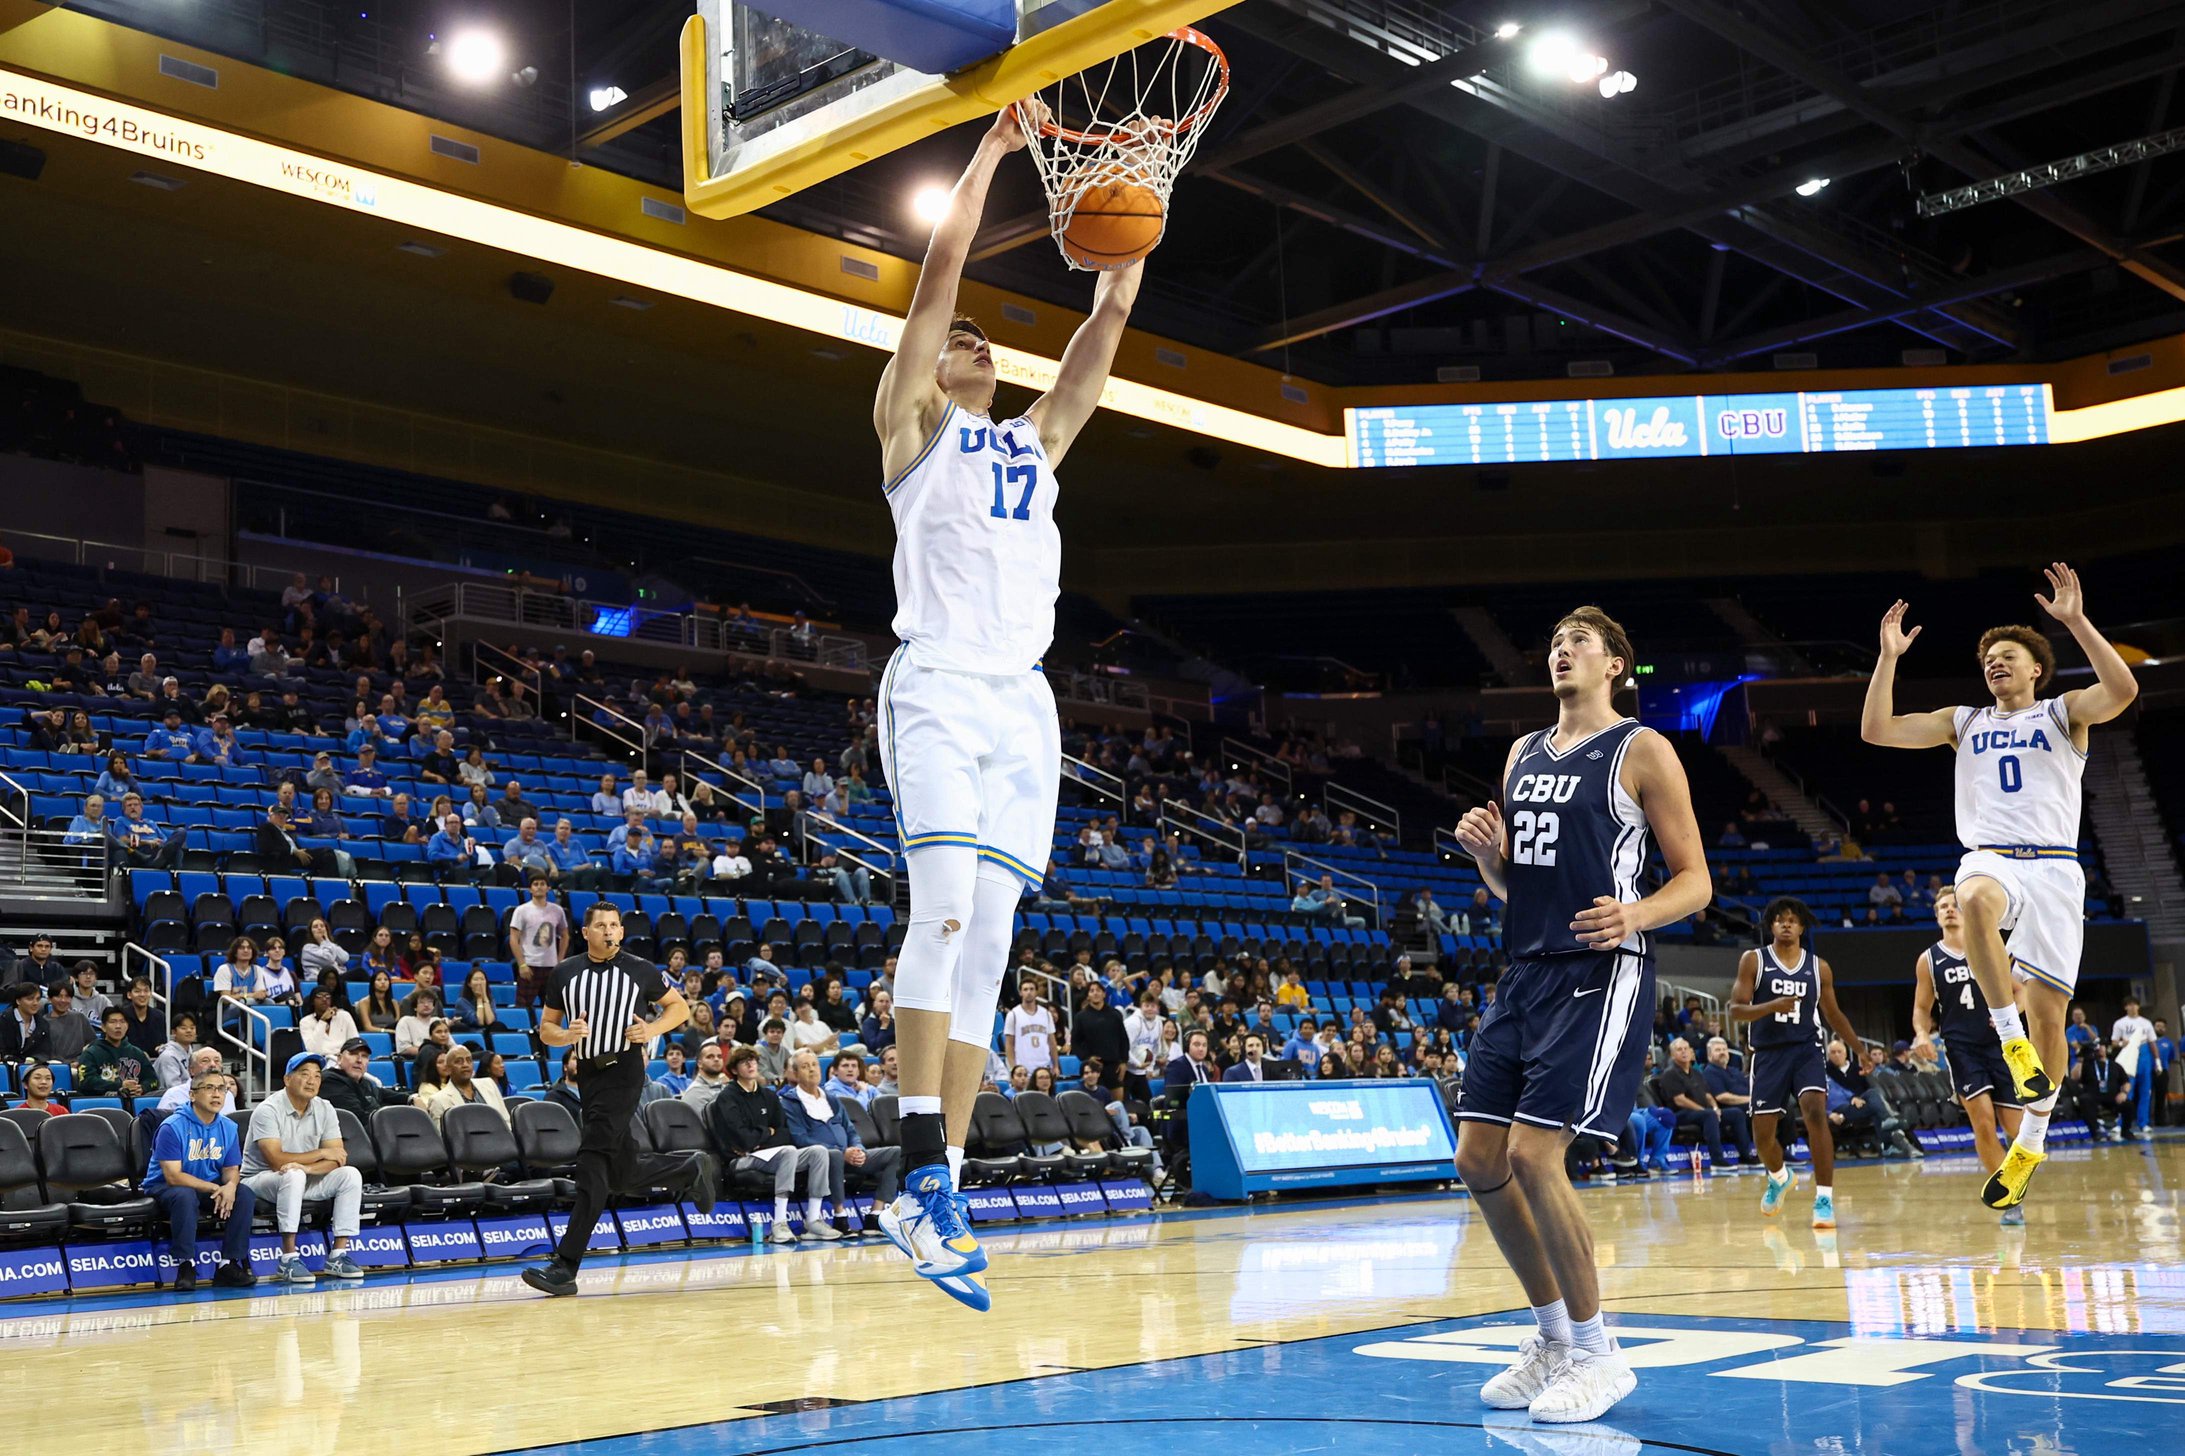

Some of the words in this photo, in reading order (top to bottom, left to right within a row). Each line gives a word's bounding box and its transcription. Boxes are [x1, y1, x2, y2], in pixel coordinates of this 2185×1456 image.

[281, 161, 350, 192] WESCOM
[843, 306, 889, 347] Ucla
[1604, 406, 1688, 449] Ucla
[1719, 409, 1786, 440] CBU
[960, 427, 1042, 459] UCL
[991, 461, 1037, 520] 17
[1972, 729, 2052, 755] UCLA
[1999, 755, 2022, 793] 0
[1512, 774, 1581, 803] CBU
[1514, 810, 1560, 867] 22
[1944, 966, 1976, 984] CB
[1771, 979, 1807, 998] CBU
[1960, 984, 1975, 1010] 4
[188, 1138, 222, 1161] Ucla
[969, 1197, 1015, 1209] SEIA.COM
[1016, 1194, 1060, 1206] SEIA.COM
[1060, 1190, 1103, 1204] SEIA.COM
[1107, 1188, 1147, 1200] SEIA.COM
[623, 1215, 682, 1232] SEIA.COM
[687, 1212, 744, 1226] SEIA.COM
[410, 1231, 477, 1248] SEIA.COM
[484, 1227, 549, 1244] SEIA.COM
[70, 1253, 154, 1272] SEIA.COM
